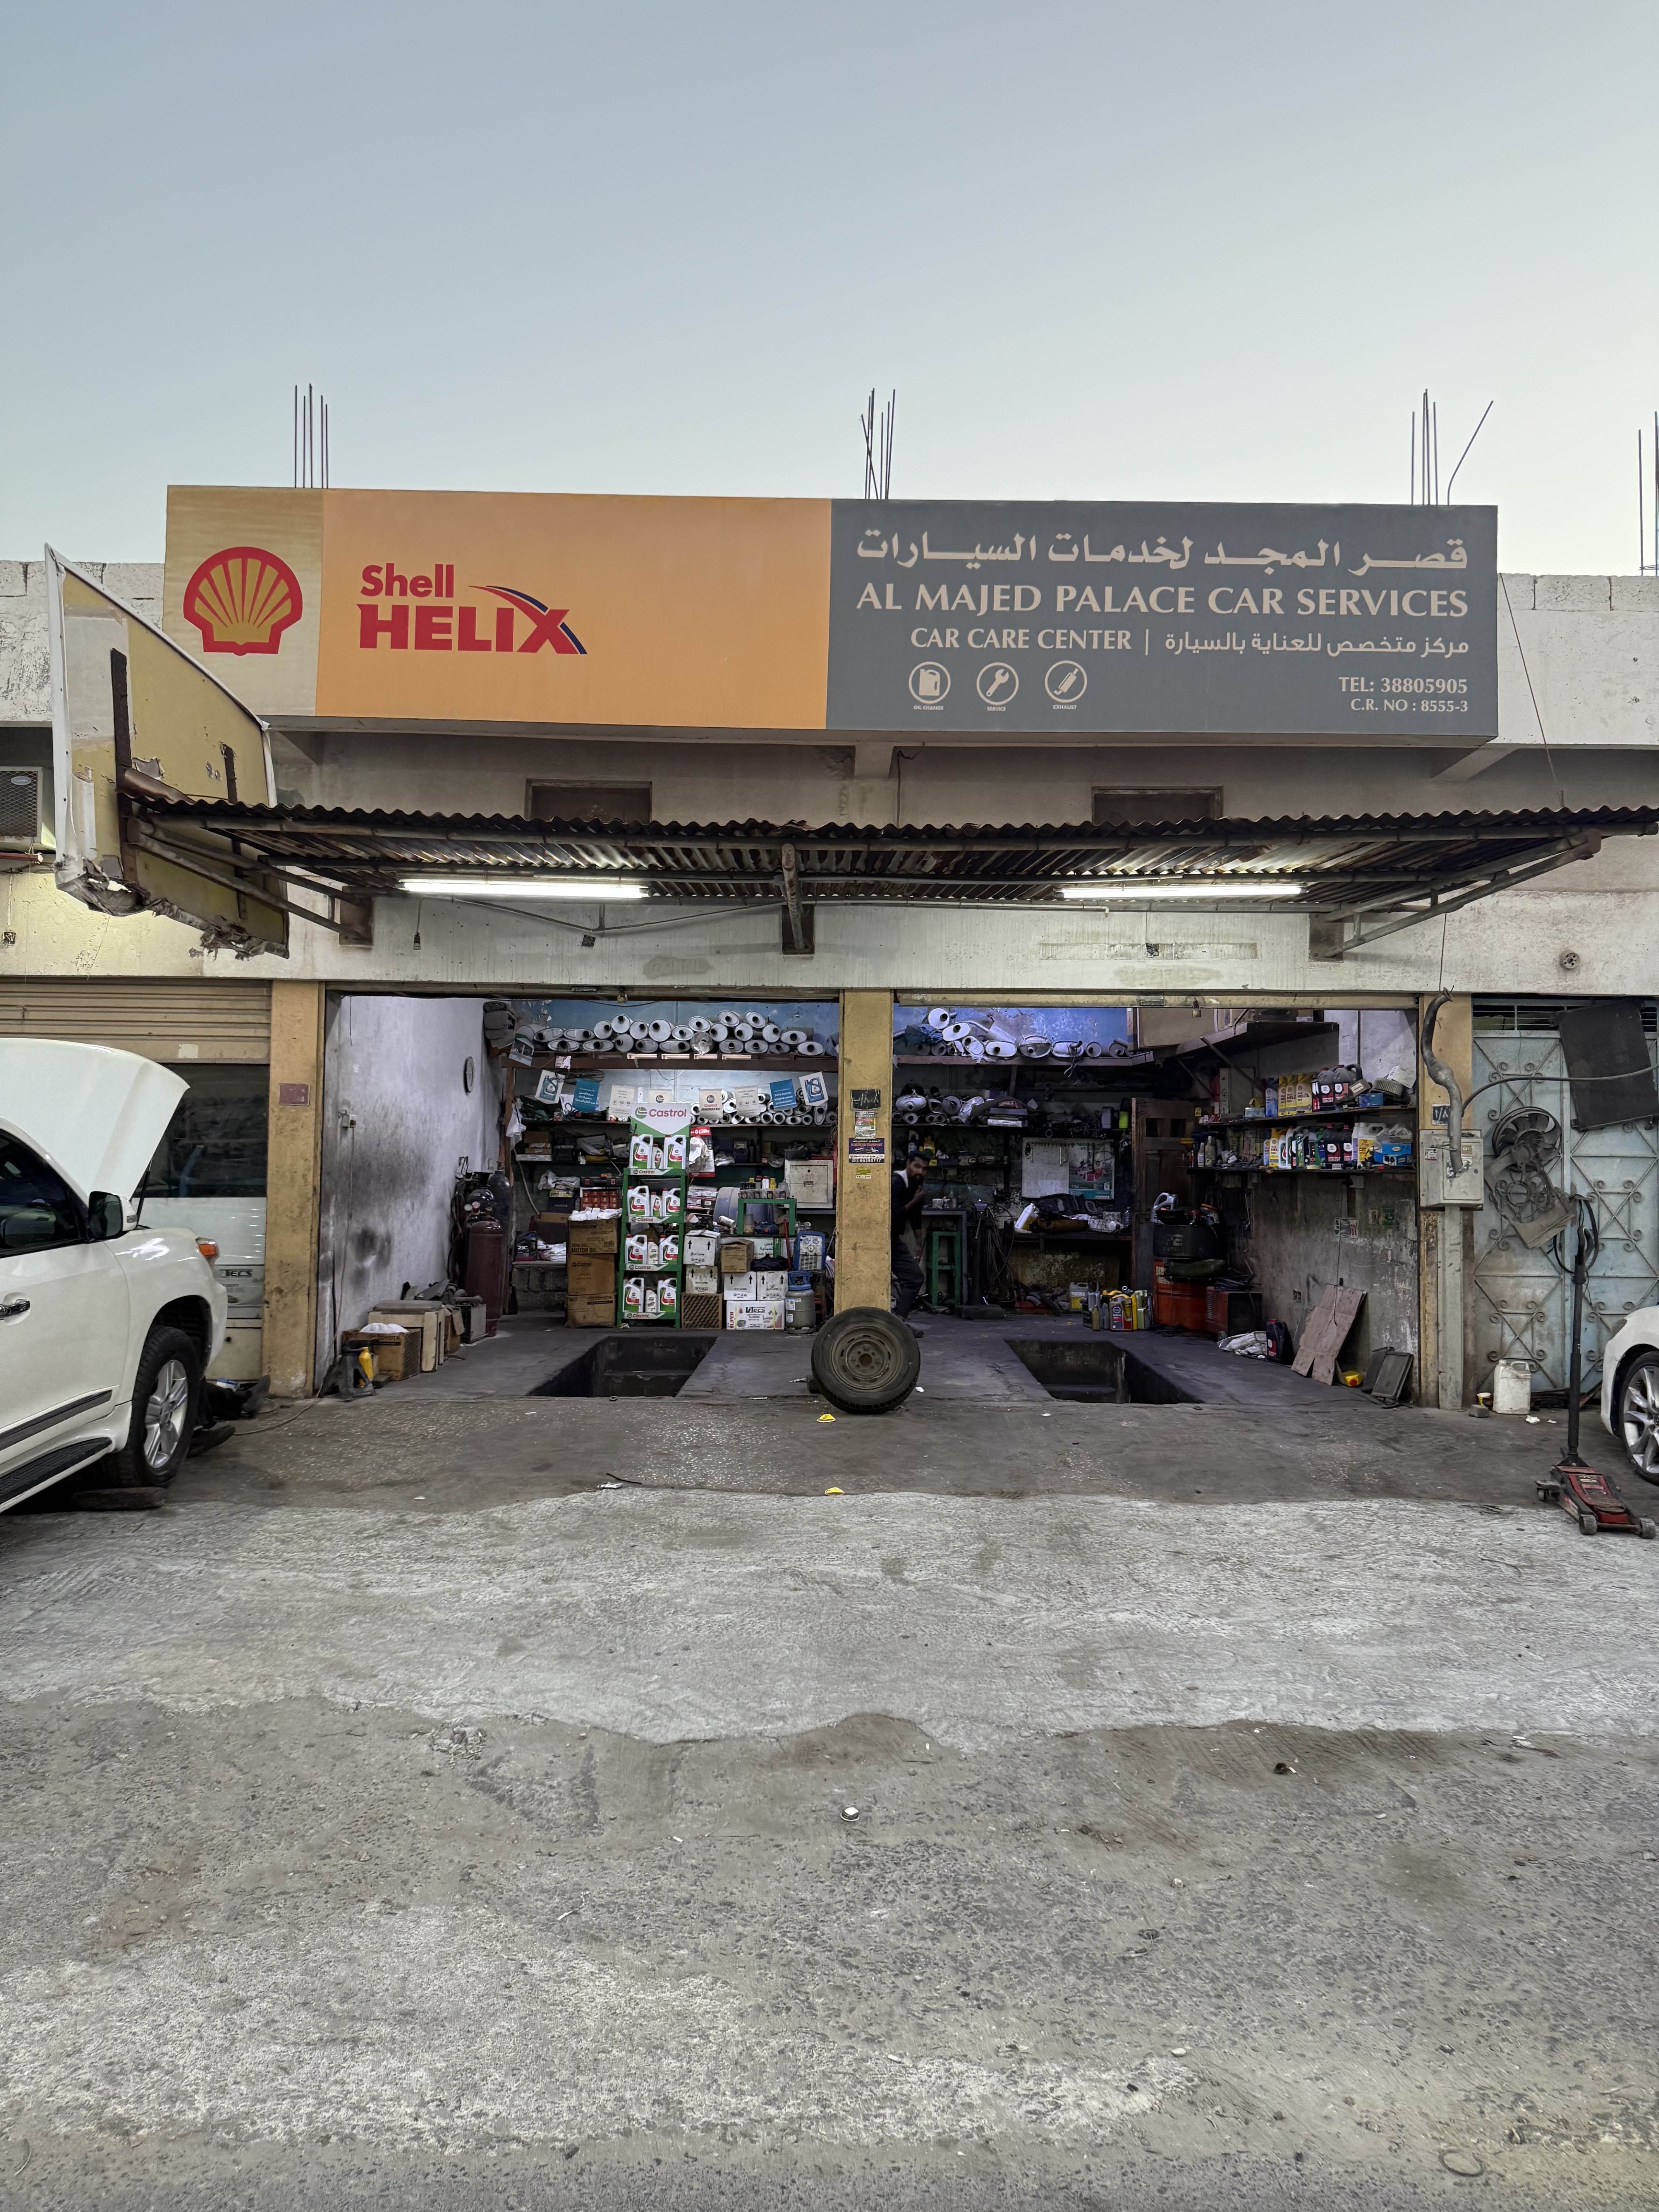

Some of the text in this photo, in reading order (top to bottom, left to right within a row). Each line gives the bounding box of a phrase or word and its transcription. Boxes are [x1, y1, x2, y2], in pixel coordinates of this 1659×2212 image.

[857, 529, 1468, 576] قصر المجد لخدمات السيارات
[361, 563, 453, 598] Shell
[856, 582, 1468, 617] AL MAJED PALACE CAR SERVICES
[357, 603, 578, 654] HELIX
[910, 627, 1132, 649] CAR CARE CENTER
[1165, 631, 1469, 659] مركز متخصص للعناية بالسيارة
[1338, 677, 1468, 694] TEL: 38805905
[1350, 698, 1379, 711] C.R.
[1383, 699, 1408, 711] NO
[1420, 699, 1468, 713] 8555-3
[649, 1109, 687, 1117] Castrol
[218, 1269, 253, 1278] TECS
